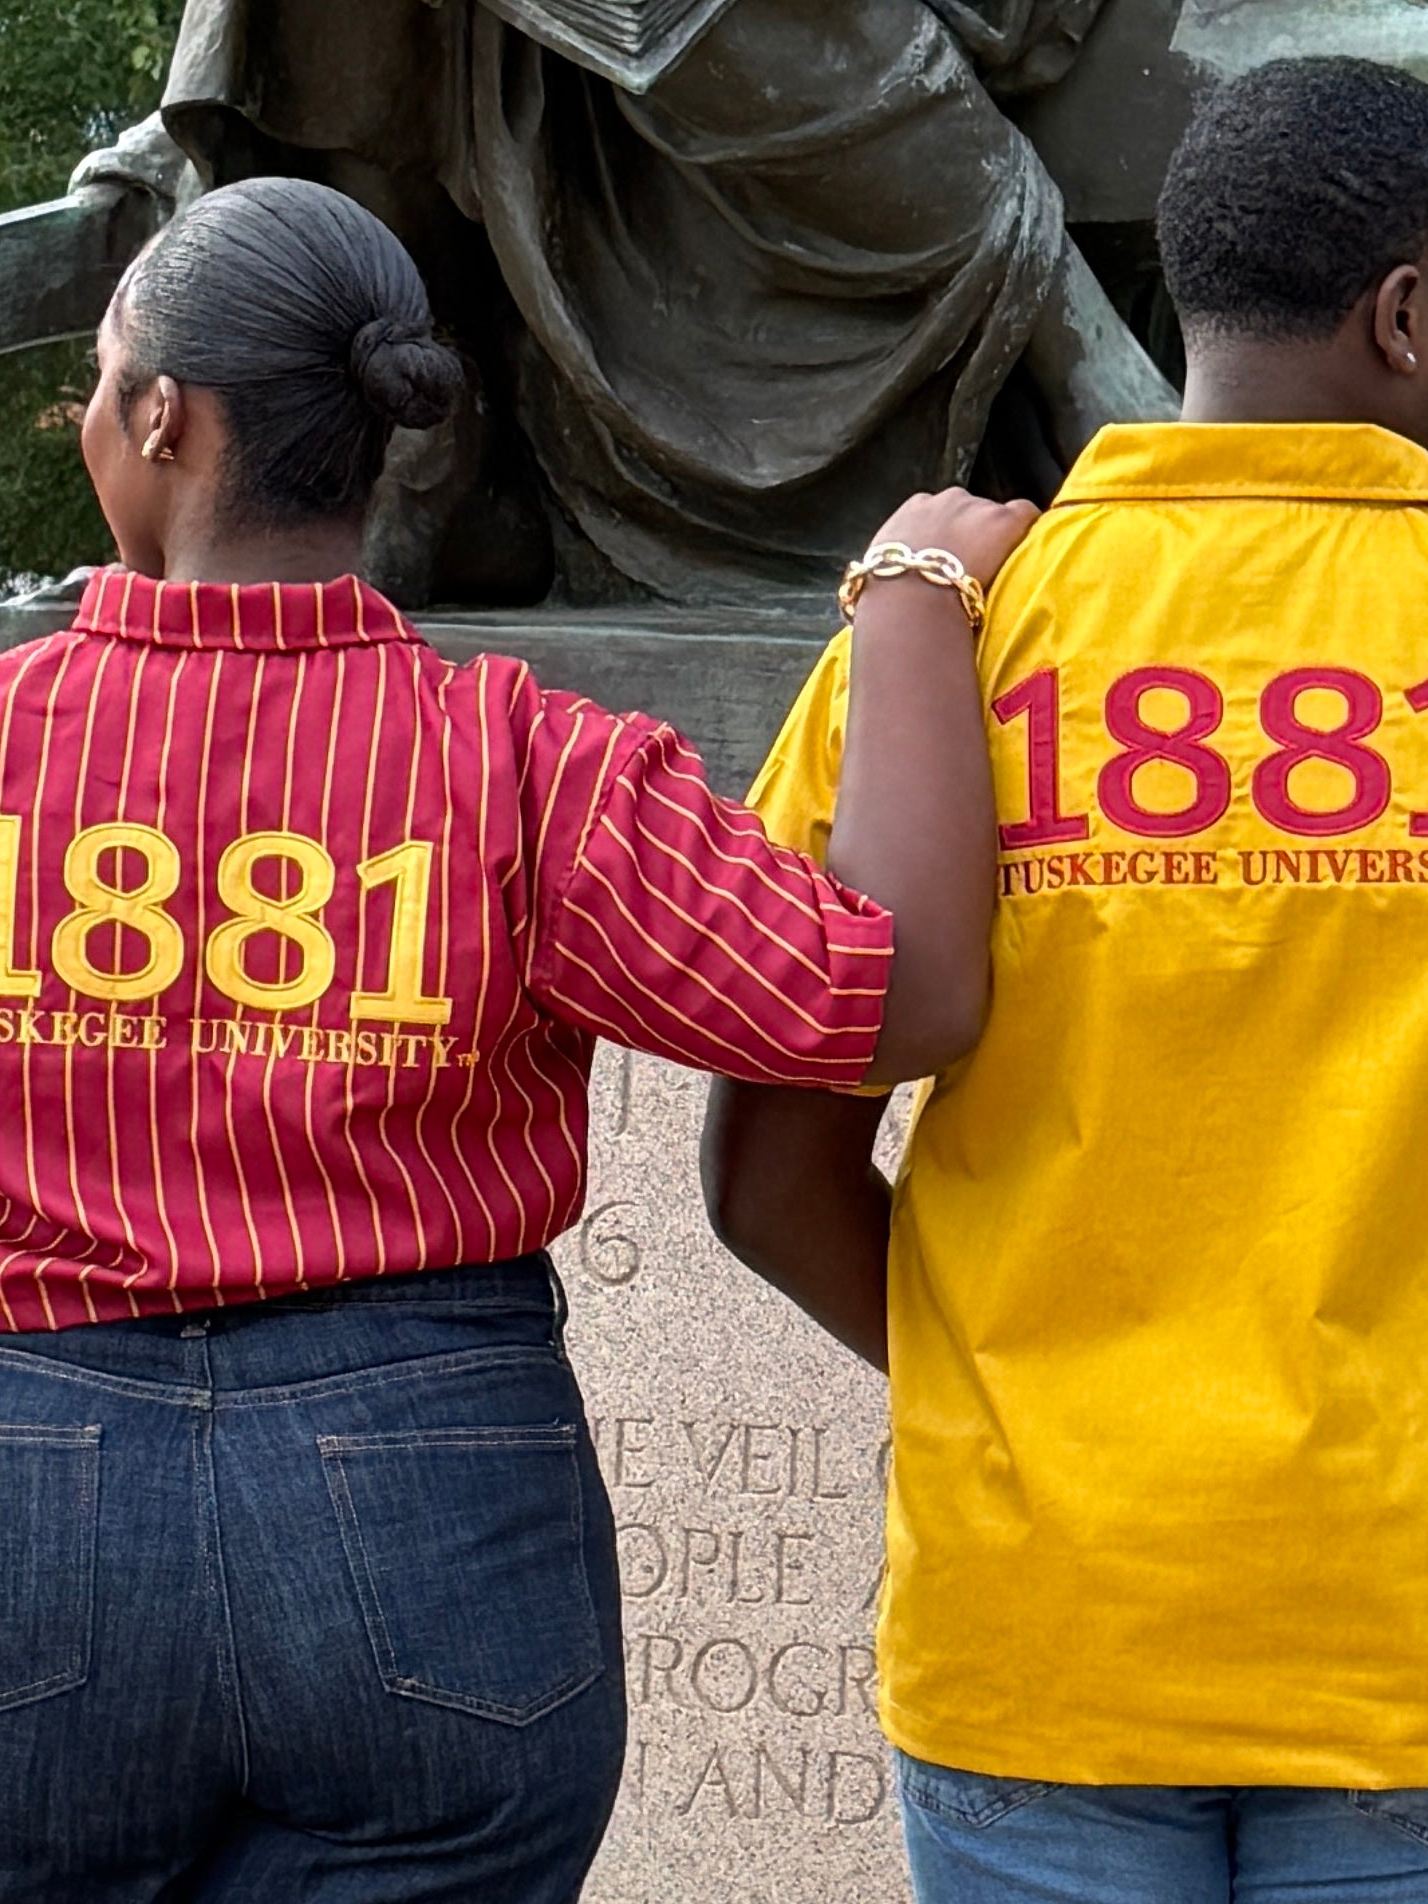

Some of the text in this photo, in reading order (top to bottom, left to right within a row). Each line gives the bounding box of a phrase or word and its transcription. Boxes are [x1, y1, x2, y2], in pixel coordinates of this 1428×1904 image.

[997, 849, 1219, 896] TUSKEGEE
[190, 1017, 459, 1068] UNIVERSITY
[677, 1423, 847, 1499] VEIL
[616, 1523, 812, 1605] OPLE
[622, 1632, 878, 1717] ROGR
[675, 1742, 886, 1825] AND
